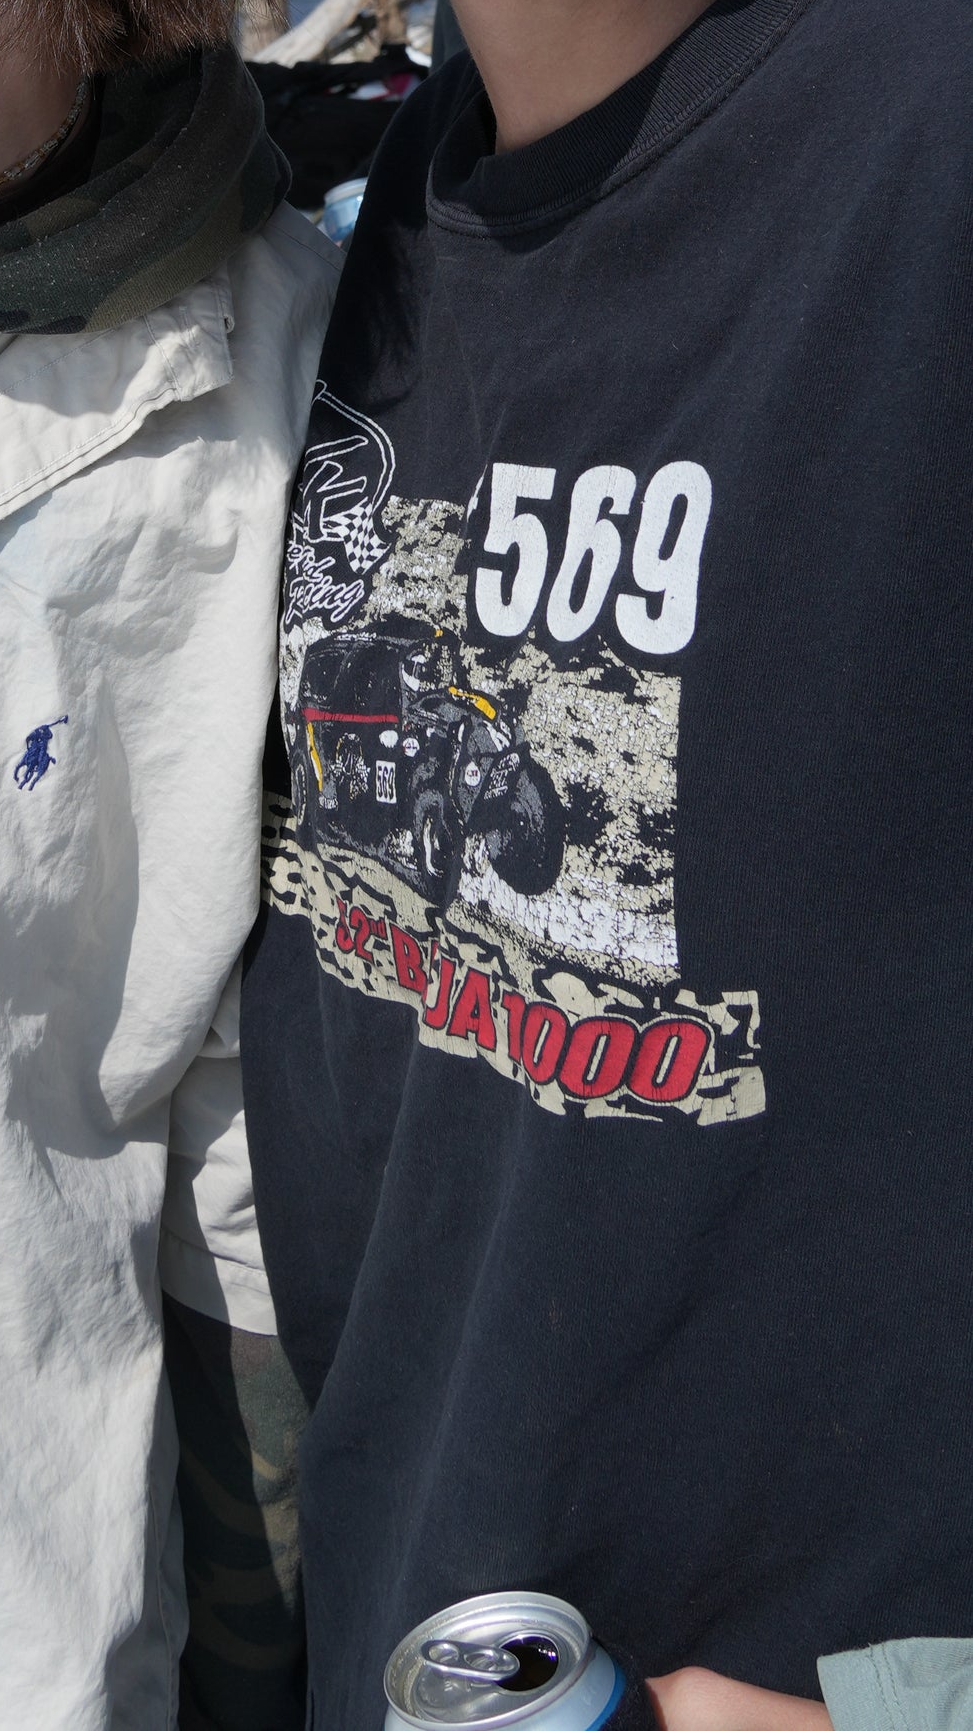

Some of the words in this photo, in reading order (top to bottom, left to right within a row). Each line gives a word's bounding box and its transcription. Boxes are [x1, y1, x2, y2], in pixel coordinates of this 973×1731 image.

[475, 460, 713, 655] 569
[377, 764, 397, 801] 569
[389, 923, 498, 1053] BJA
